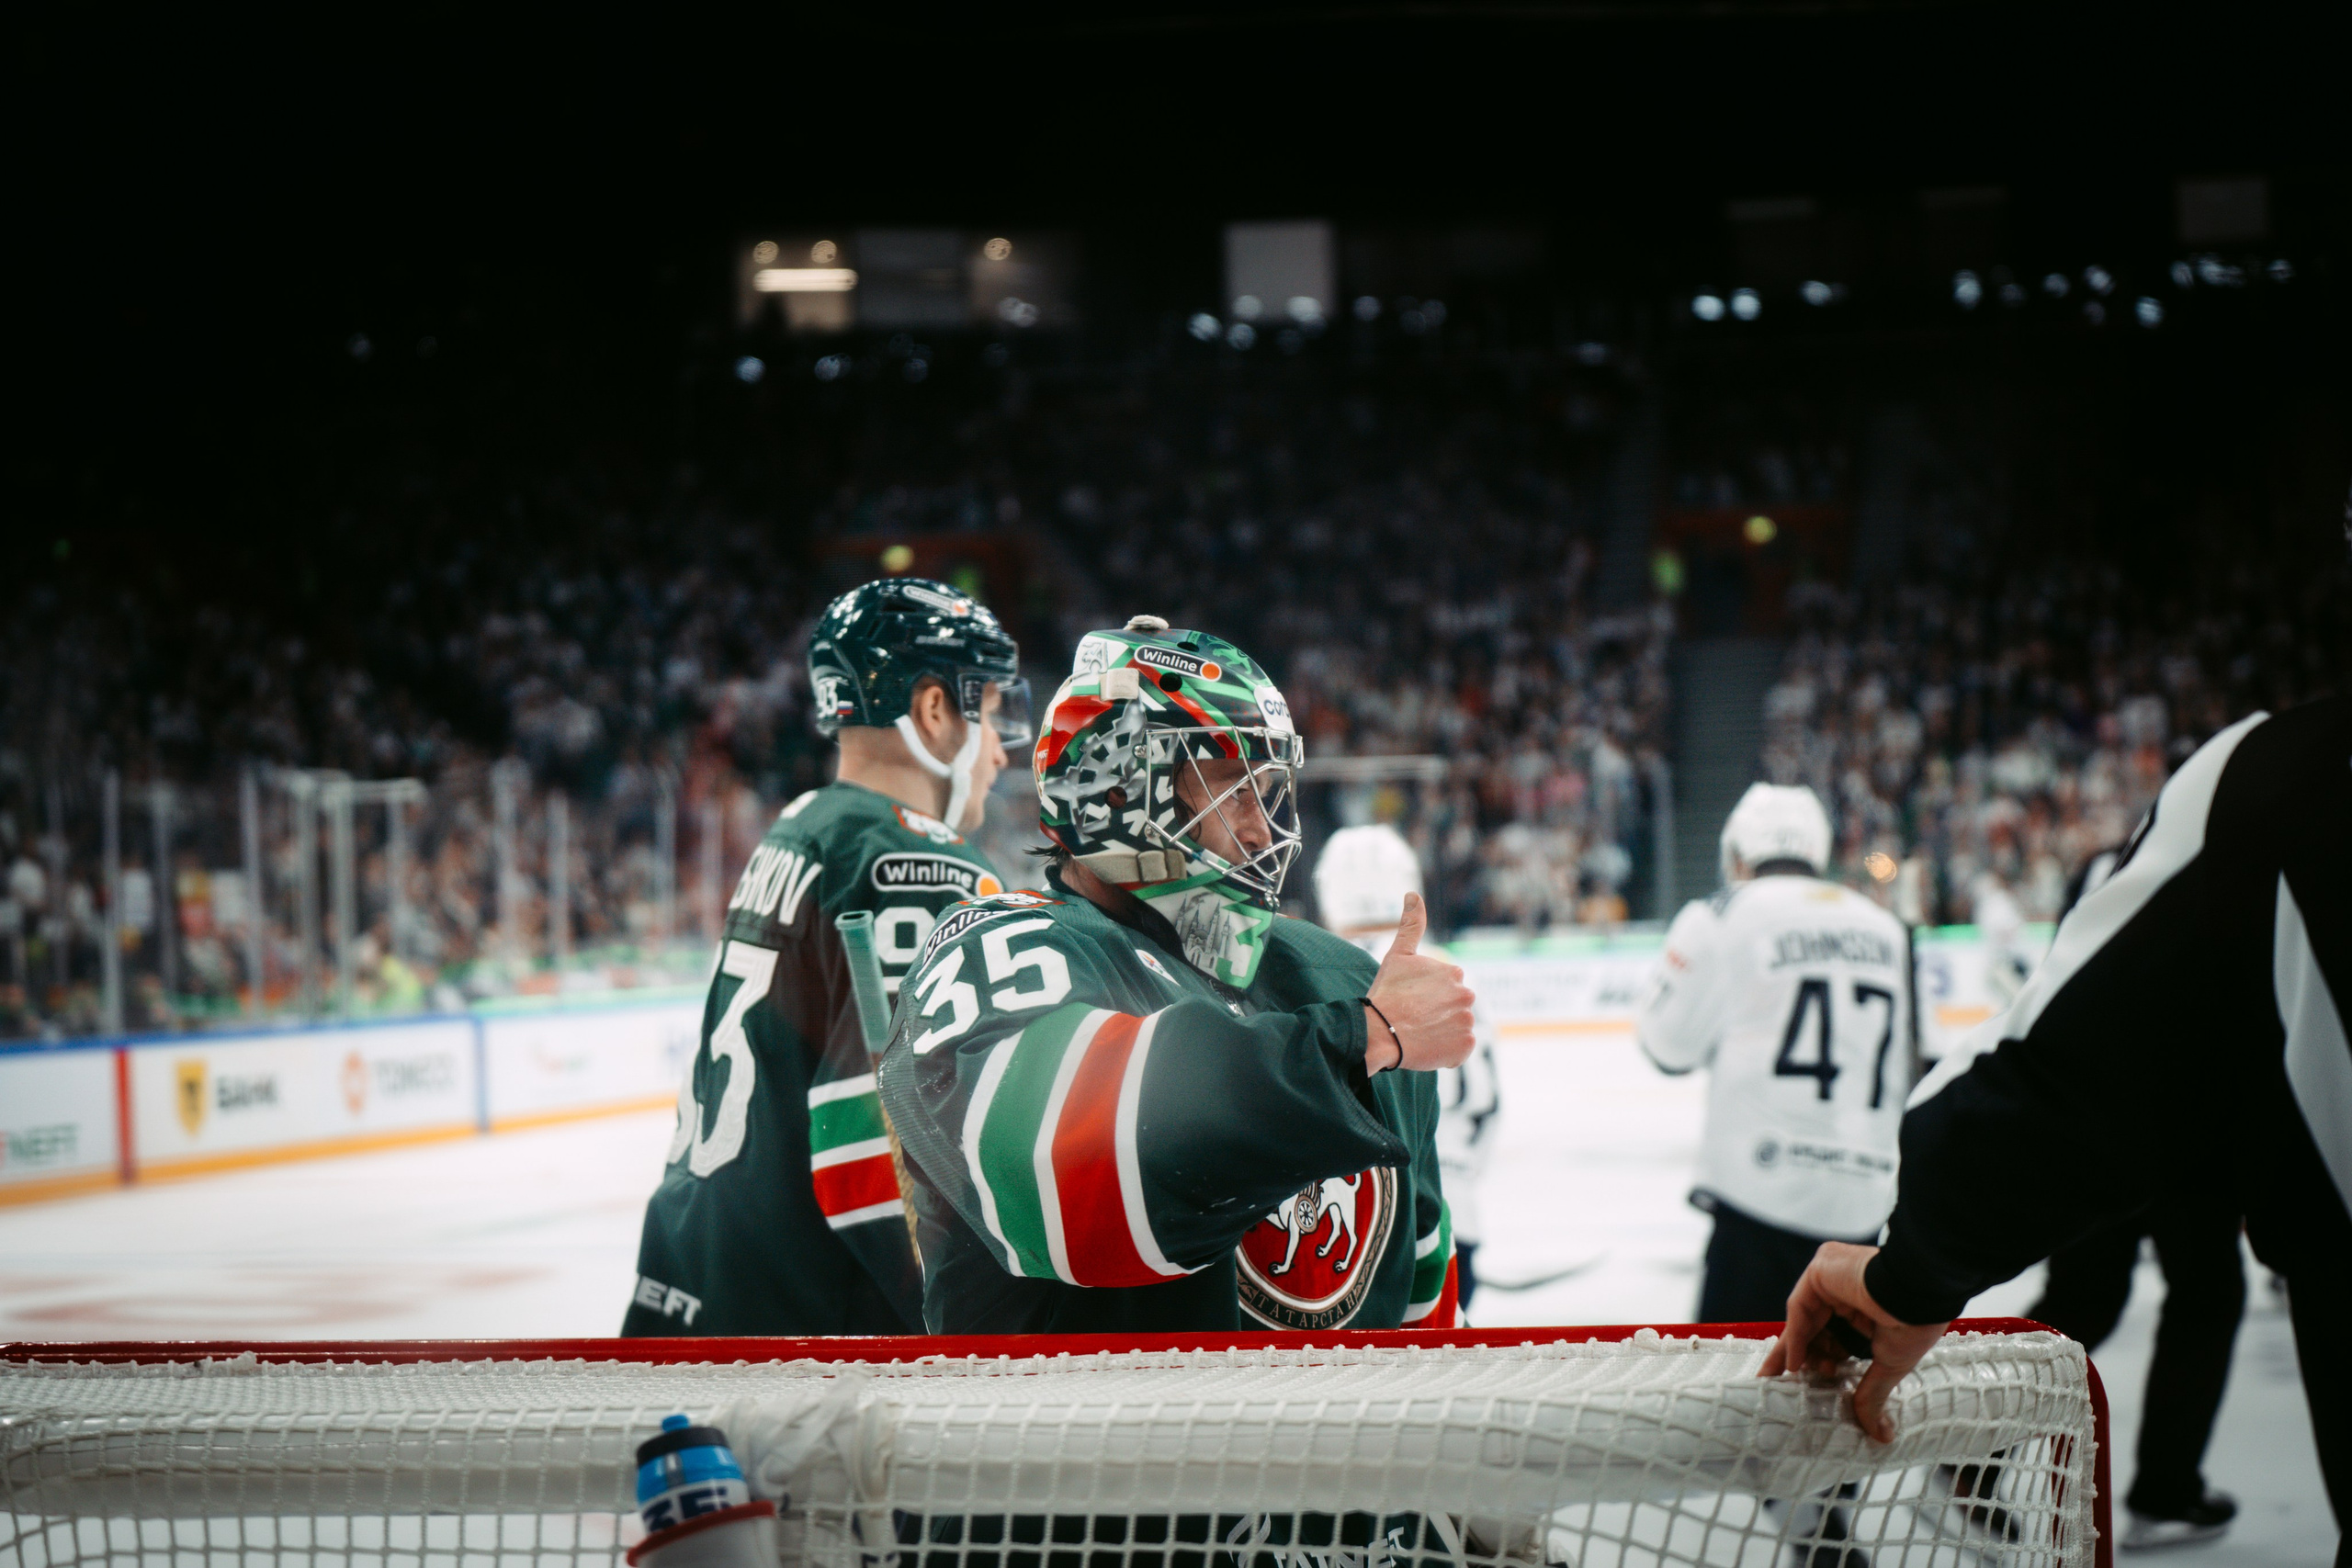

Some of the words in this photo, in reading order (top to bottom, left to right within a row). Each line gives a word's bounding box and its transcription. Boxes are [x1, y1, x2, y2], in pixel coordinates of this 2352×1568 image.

[1142, 648, 1198, 672] Winline
[884, 859, 974, 889] Winline
[925, 909, 1011, 956] Winlin
[913, 919, 1072, 1055] 35
[1775, 978, 1894, 1110] 47
[0, 1122, 78, 1164] NEFT
[1258, 1293, 1356, 1328] ТАТАРСТАН
